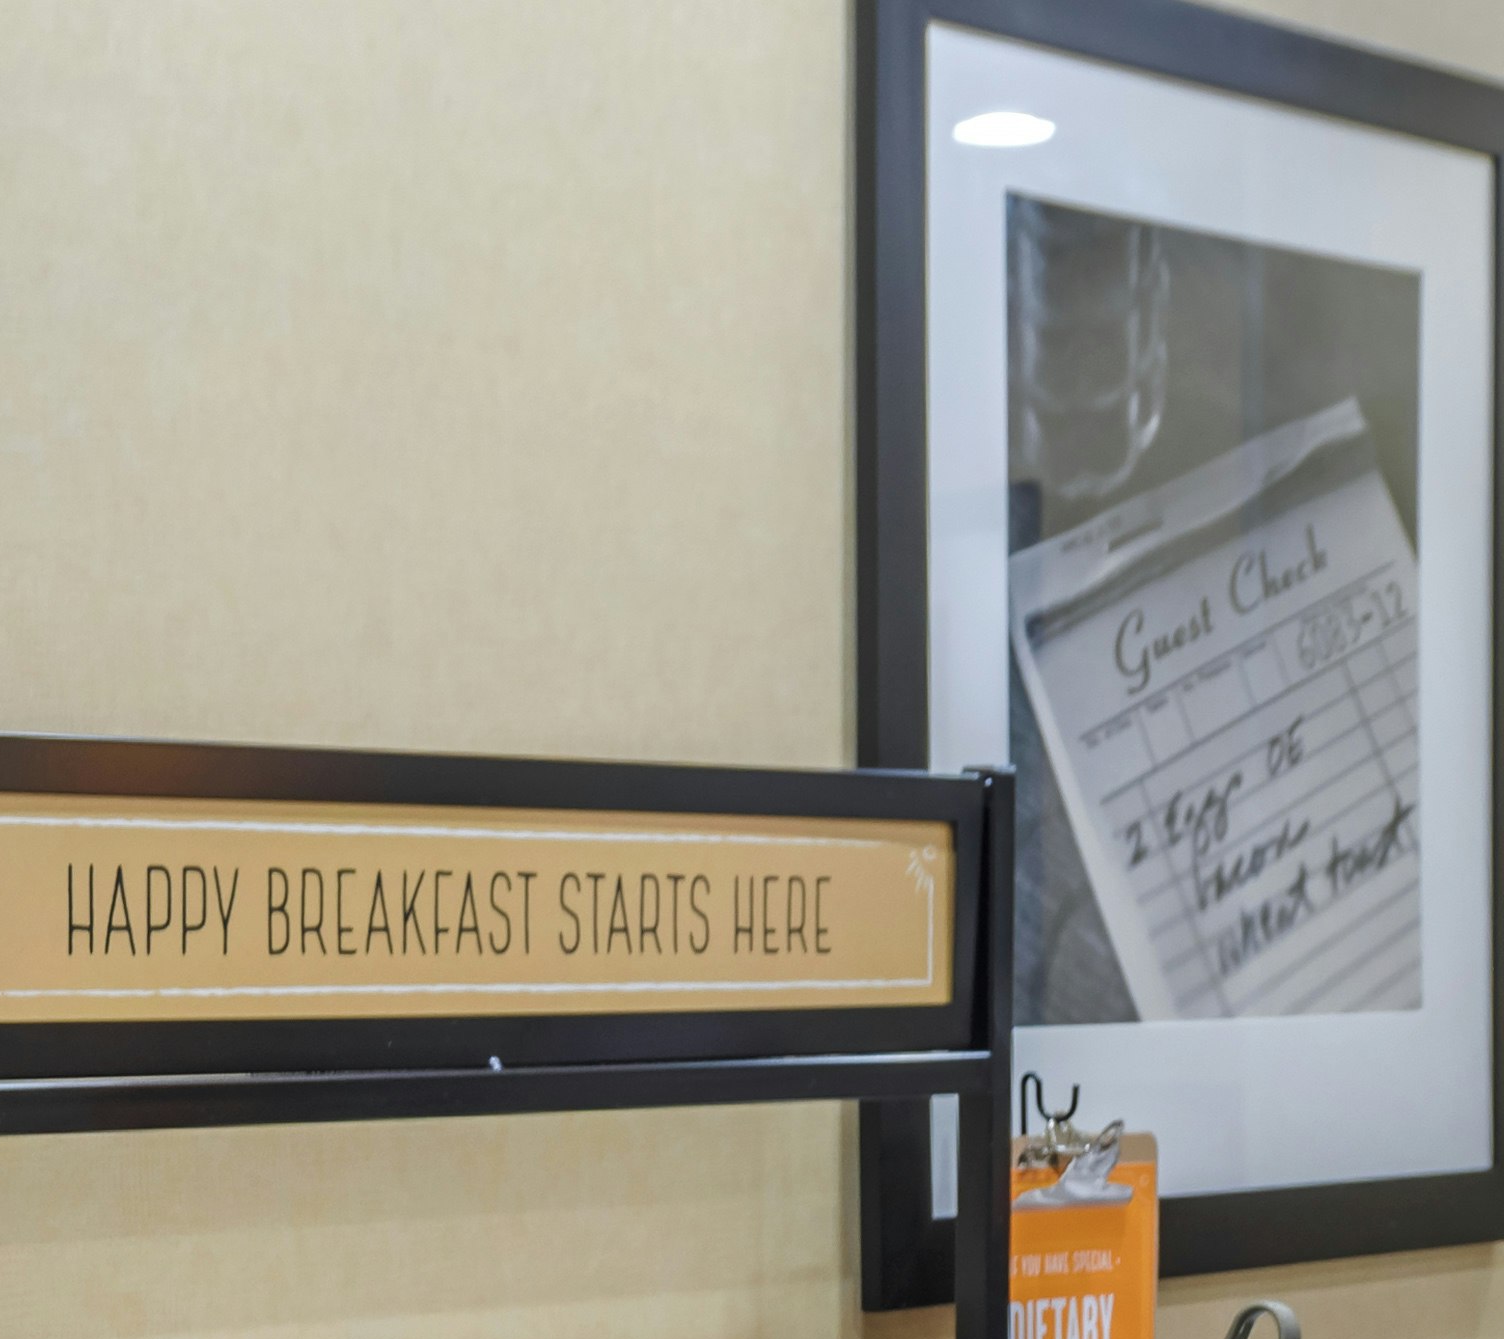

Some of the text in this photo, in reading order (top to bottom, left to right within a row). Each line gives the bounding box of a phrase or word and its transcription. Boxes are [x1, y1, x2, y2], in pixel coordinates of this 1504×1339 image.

[1114, 524, 1328, 695] Guest Check
[65, 862, 834, 958] HAPPY BREAKFAST STARTS HERE
